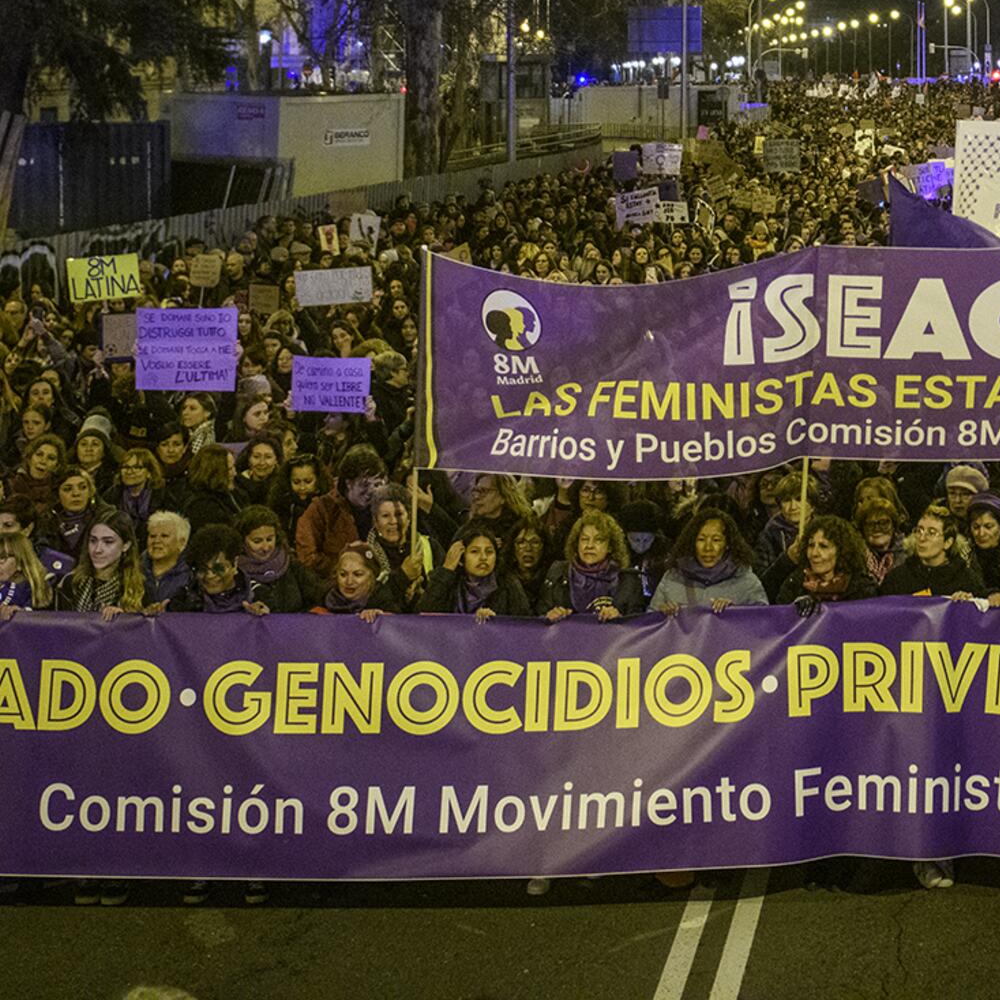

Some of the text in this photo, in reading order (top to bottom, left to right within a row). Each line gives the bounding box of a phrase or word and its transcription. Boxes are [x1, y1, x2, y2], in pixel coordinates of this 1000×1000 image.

[88, 256, 117, 277] 8M
[71, 273, 141, 300] LATINA
[196, 326, 226, 338] TUTTO
[493, 352, 541, 375] 8M
[335, 380, 363, 393] LIBRE
[496, 374, 544, 386] Madrid
[491, 381, 582, 419] LAS
[587, 371, 878, 421] FEMINISTAS
[490, 427, 597, 460] Barrios
[605, 438, 625, 471] y
[635, 430, 776, 464] Pueblos
[786, 417, 946, 447] Comisión
[203, 649, 756, 736] GENOCIDIOS
[39, 782, 304, 835] Comisión
[327, 785, 416, 835] 8M
[439, 776, 772, 834] Movimiento
